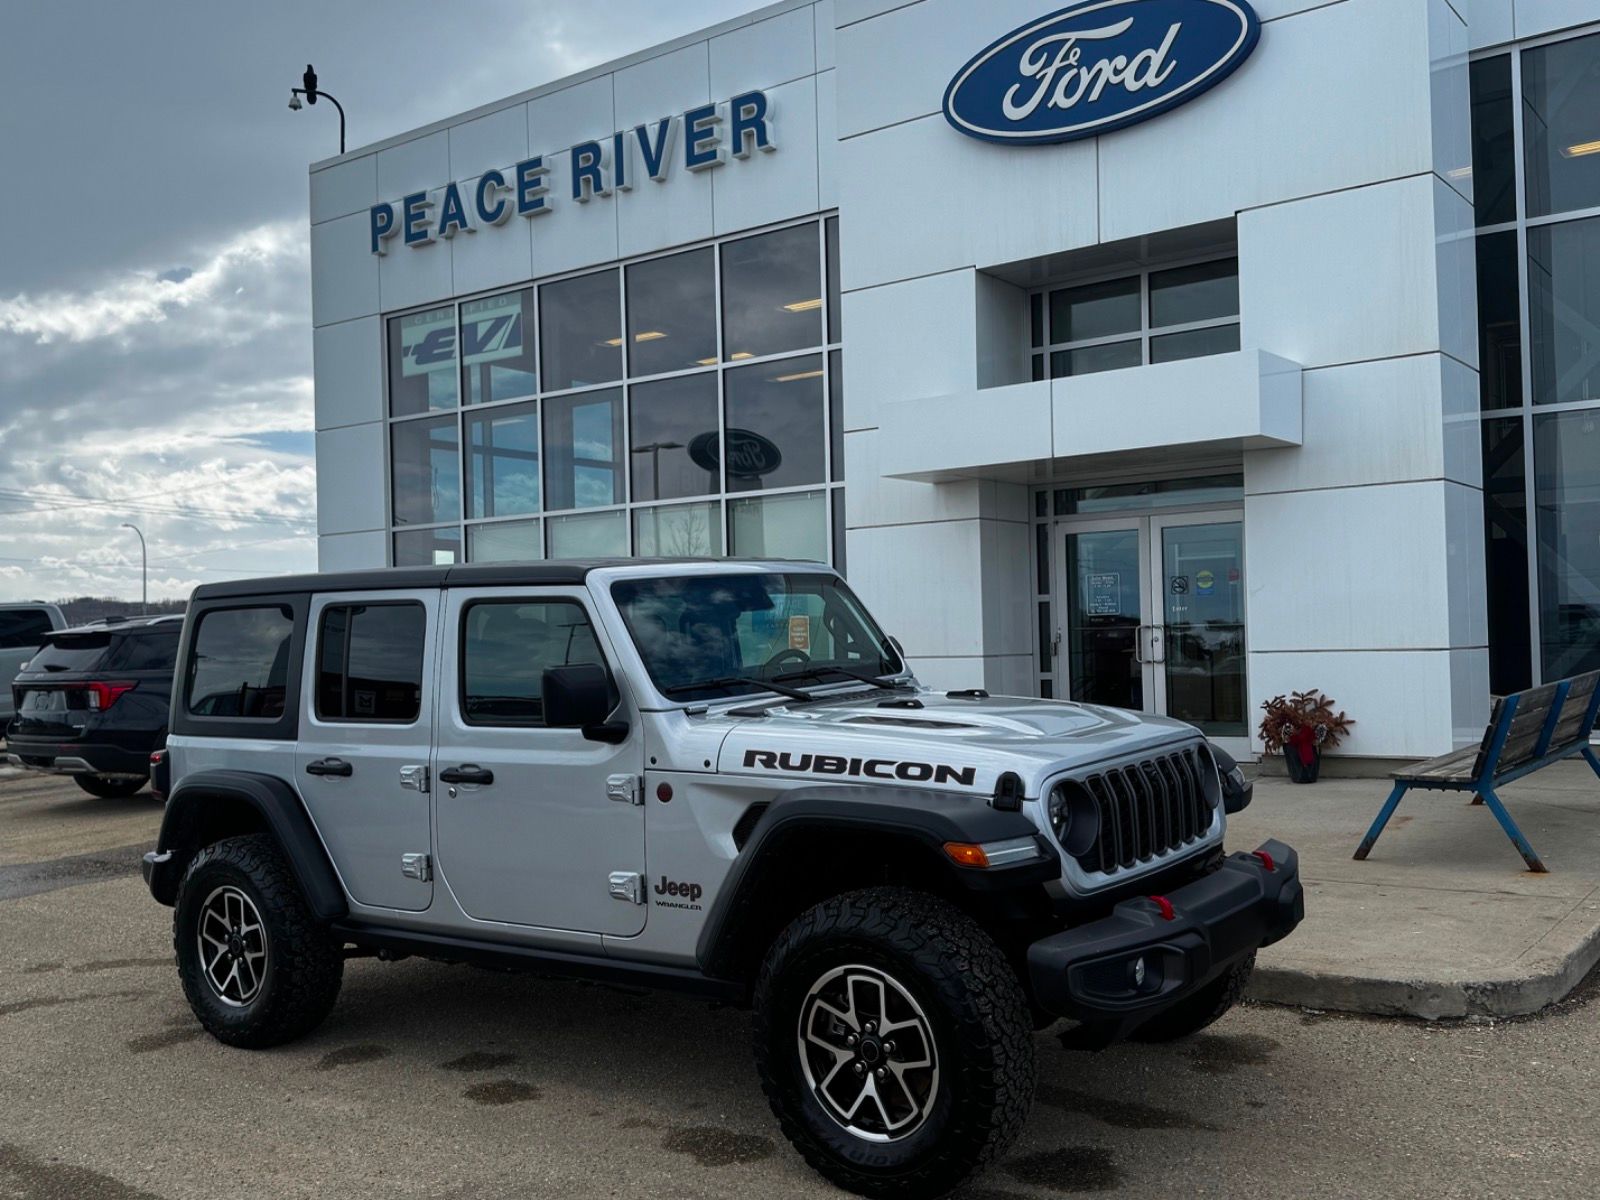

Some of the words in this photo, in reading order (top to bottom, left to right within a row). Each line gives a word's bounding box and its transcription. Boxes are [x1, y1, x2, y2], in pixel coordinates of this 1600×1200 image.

[1002, 16, 1182, 121] Ford
[370, 155, 552, 256] PEACE
[570, 90, 776, 203] RIVER
[742, 749, 976, 786] RUBICON
[654, 875, 702, 902] Jeep
[655, 900, 702, 911] WRANGLER
